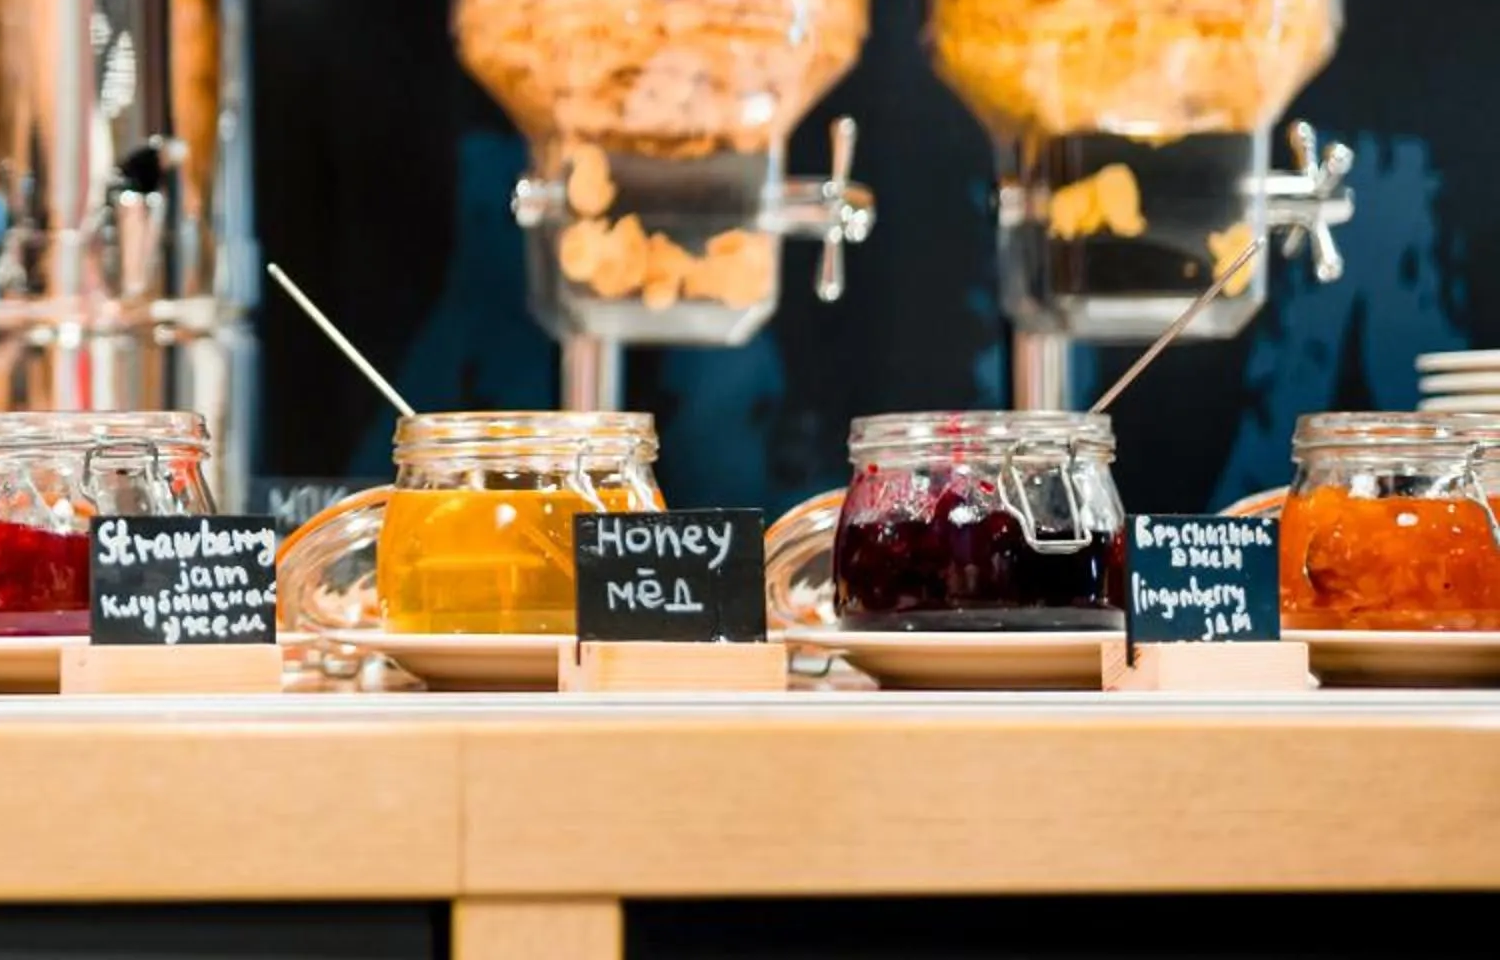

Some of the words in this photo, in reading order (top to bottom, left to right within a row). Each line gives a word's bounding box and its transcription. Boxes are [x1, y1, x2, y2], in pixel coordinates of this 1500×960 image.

[98, 518, 275, 567] Strawberry
[596, 517, 732, 569] Honey
[174, 560, 248, 593] jam
